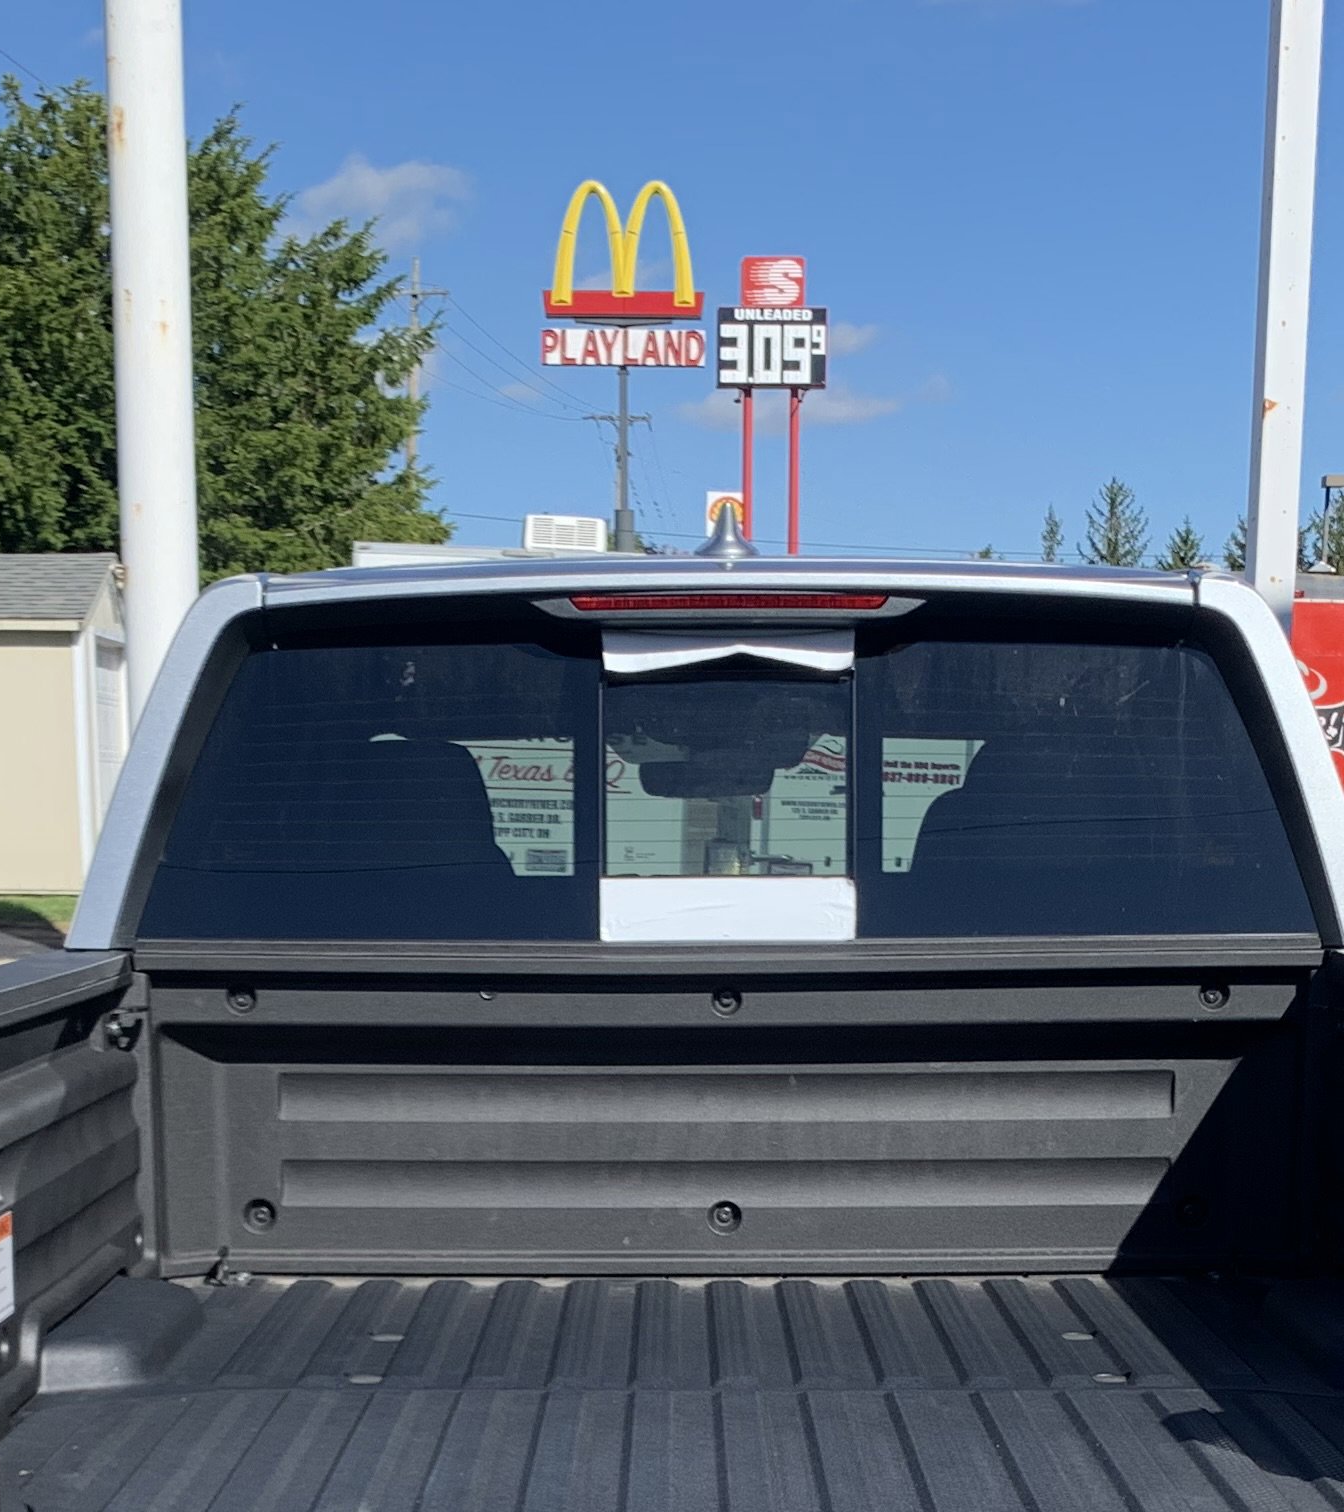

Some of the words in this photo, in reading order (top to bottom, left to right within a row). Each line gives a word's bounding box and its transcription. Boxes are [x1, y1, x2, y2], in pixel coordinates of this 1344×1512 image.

[734, 308, 813, 321] UNLEADED
[541, 329, 705, 366] PLAYLAND
[488, 756, 554, 782] Texas
